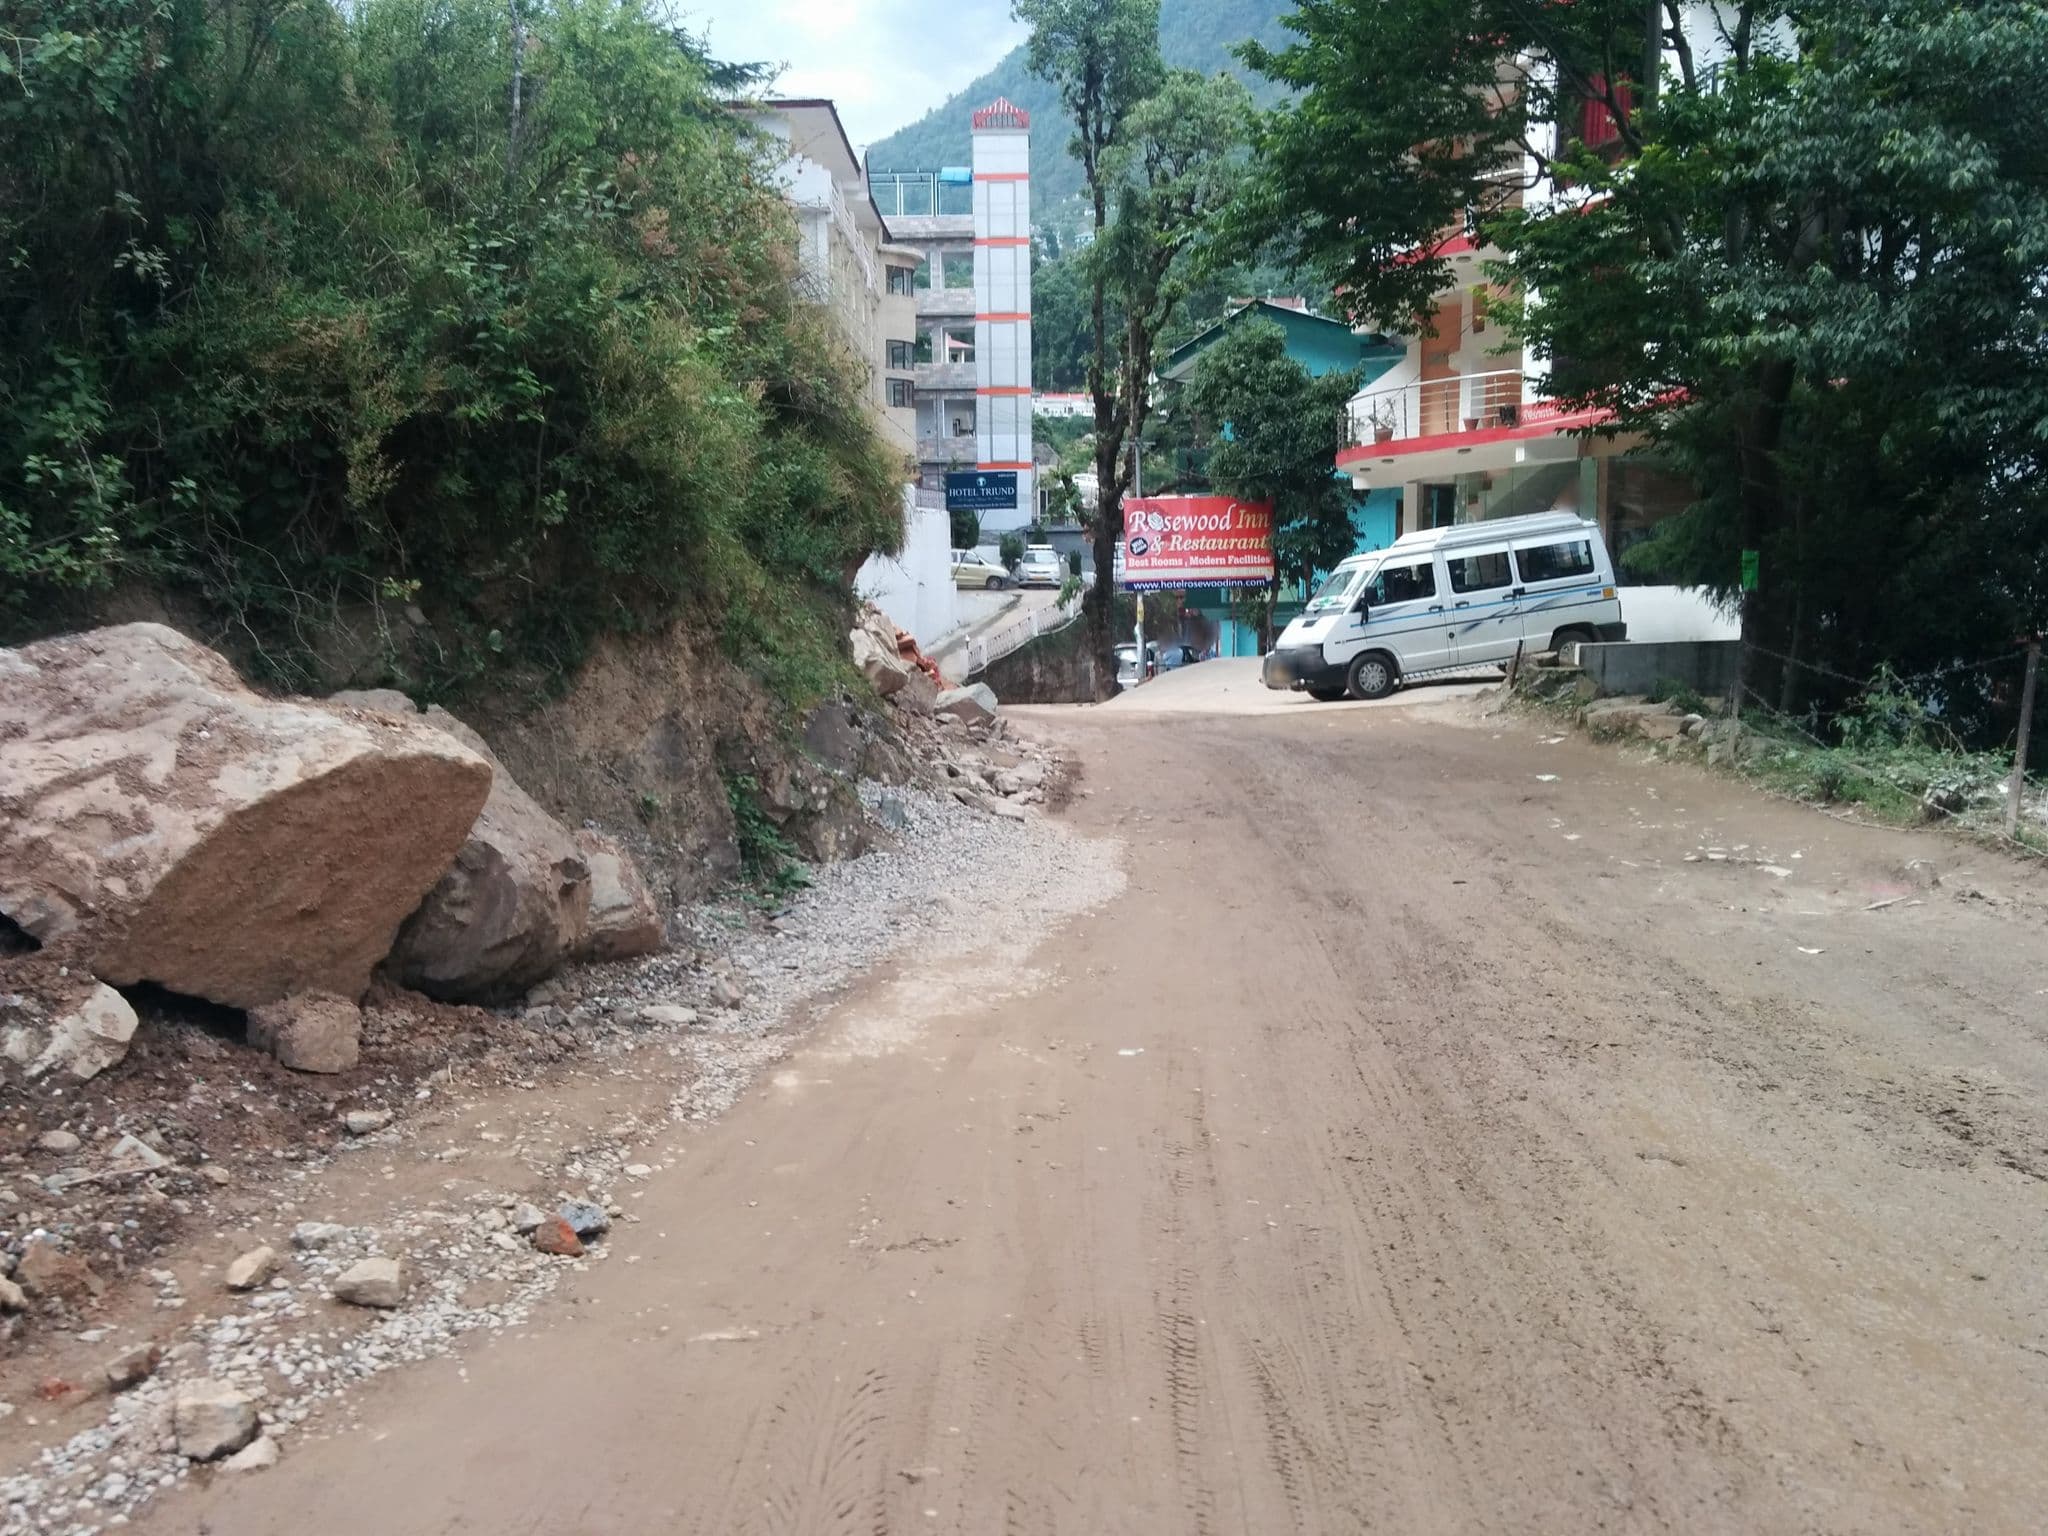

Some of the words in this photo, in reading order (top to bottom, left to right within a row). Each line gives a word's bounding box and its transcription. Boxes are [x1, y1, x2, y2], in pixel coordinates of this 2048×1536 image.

[949, 488, 977, 497] HOTEL
[981, 486, 1015, 497] TRIUND
[1236, 509, 1270, 529] Inn
[1150, 534, 1165, 557] &
[1169, 534, 1269, 552] Restaurant
[1128, 558, 1149, 567] Best
[1150, 557, 1183, 567] Rooms
[1189, 556, 1226, 566] Modern
[1228, 555, 1271, 565] Facilities
[1133, 578, 1266, 590] www.hotelrosewoodinn.com
